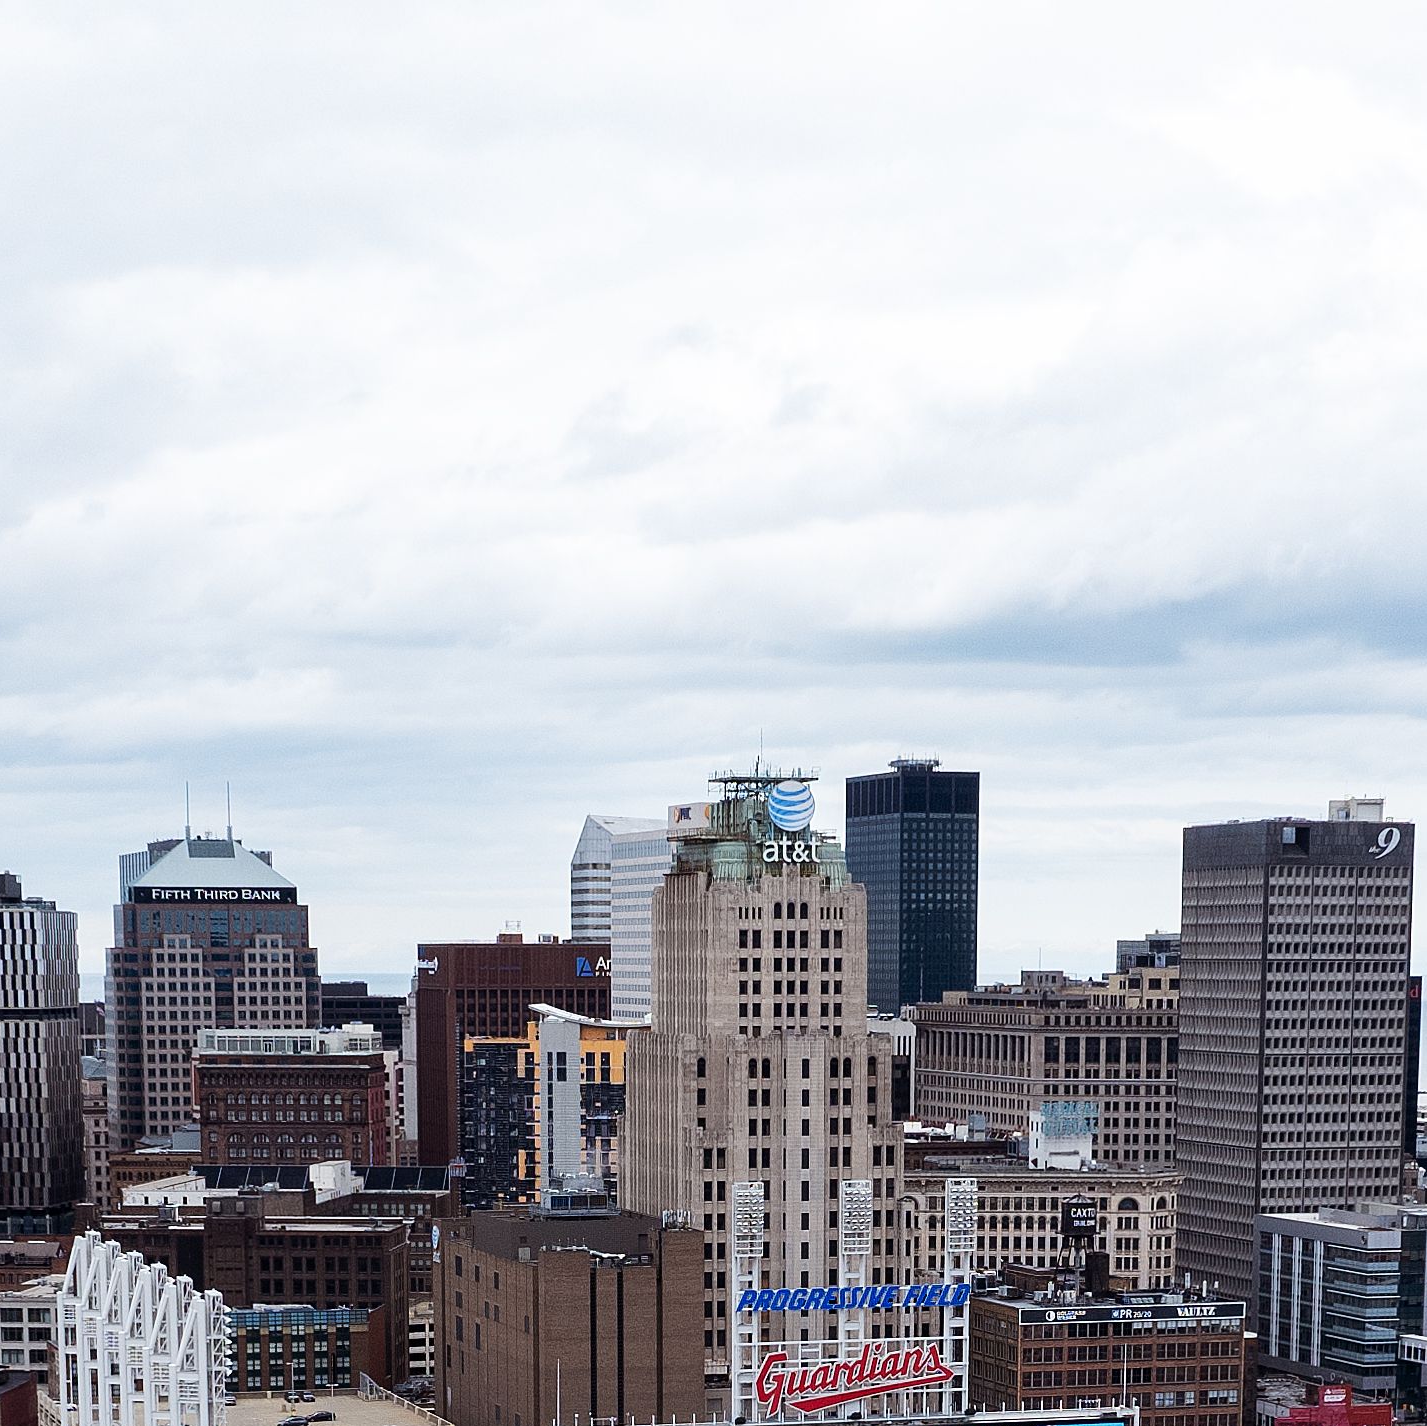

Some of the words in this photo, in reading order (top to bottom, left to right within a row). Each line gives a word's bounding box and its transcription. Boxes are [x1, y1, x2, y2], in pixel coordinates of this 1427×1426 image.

[763, 835, 821, 863] at&t
[1374, 827, 1401, 859] 9
[152, 889, 190, 900] FIFTH
[194, 889, 238, 900] THIRD
[241, 889, 280, 900] BANK
[736, 1285, 900, 1312] PROGRESSIVE
[903, 1284, 971, 1307] FIELD
[1176, 1306, 1217, 1317] VAULTZ
[756, 1342, 954, 1419] Guardians
